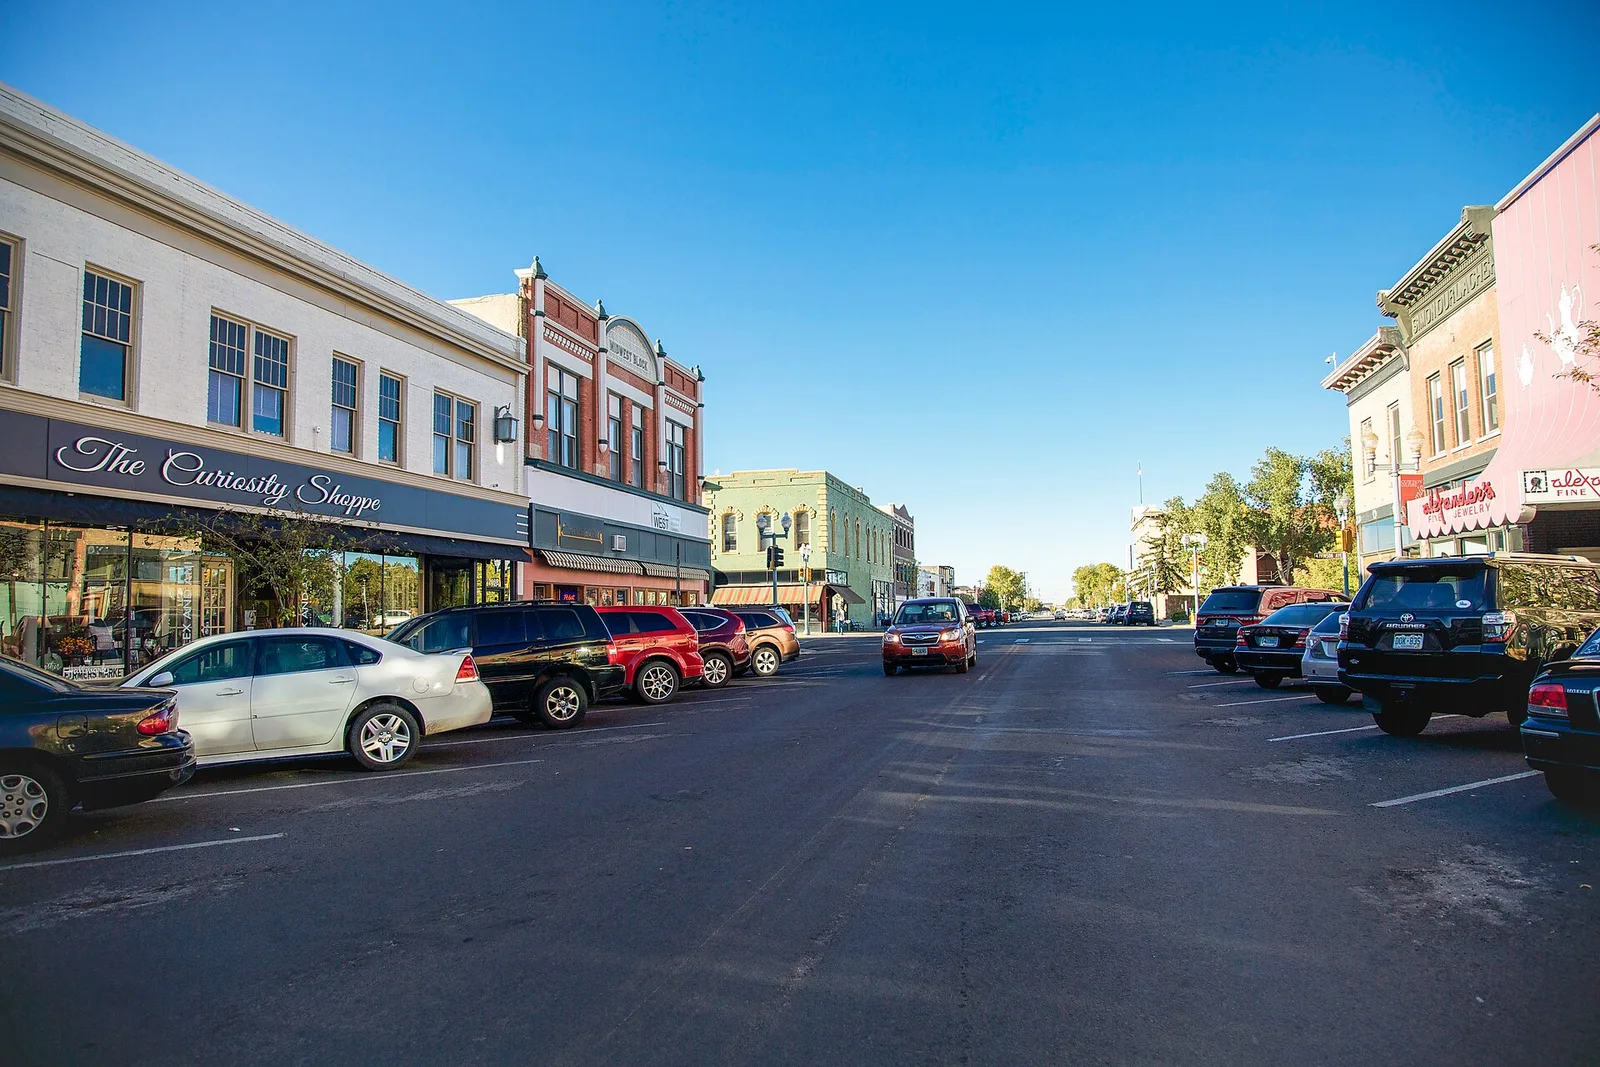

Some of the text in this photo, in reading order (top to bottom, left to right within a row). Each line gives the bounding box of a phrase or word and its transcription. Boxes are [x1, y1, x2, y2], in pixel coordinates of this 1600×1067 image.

[56, 436, 381, 516] The Curiosity Shoppe
[1557, 488, 1587, 497] FINE
[1453, 502, 1492, 519] JEWELRY
[653, 515, 669, 530] WEST
